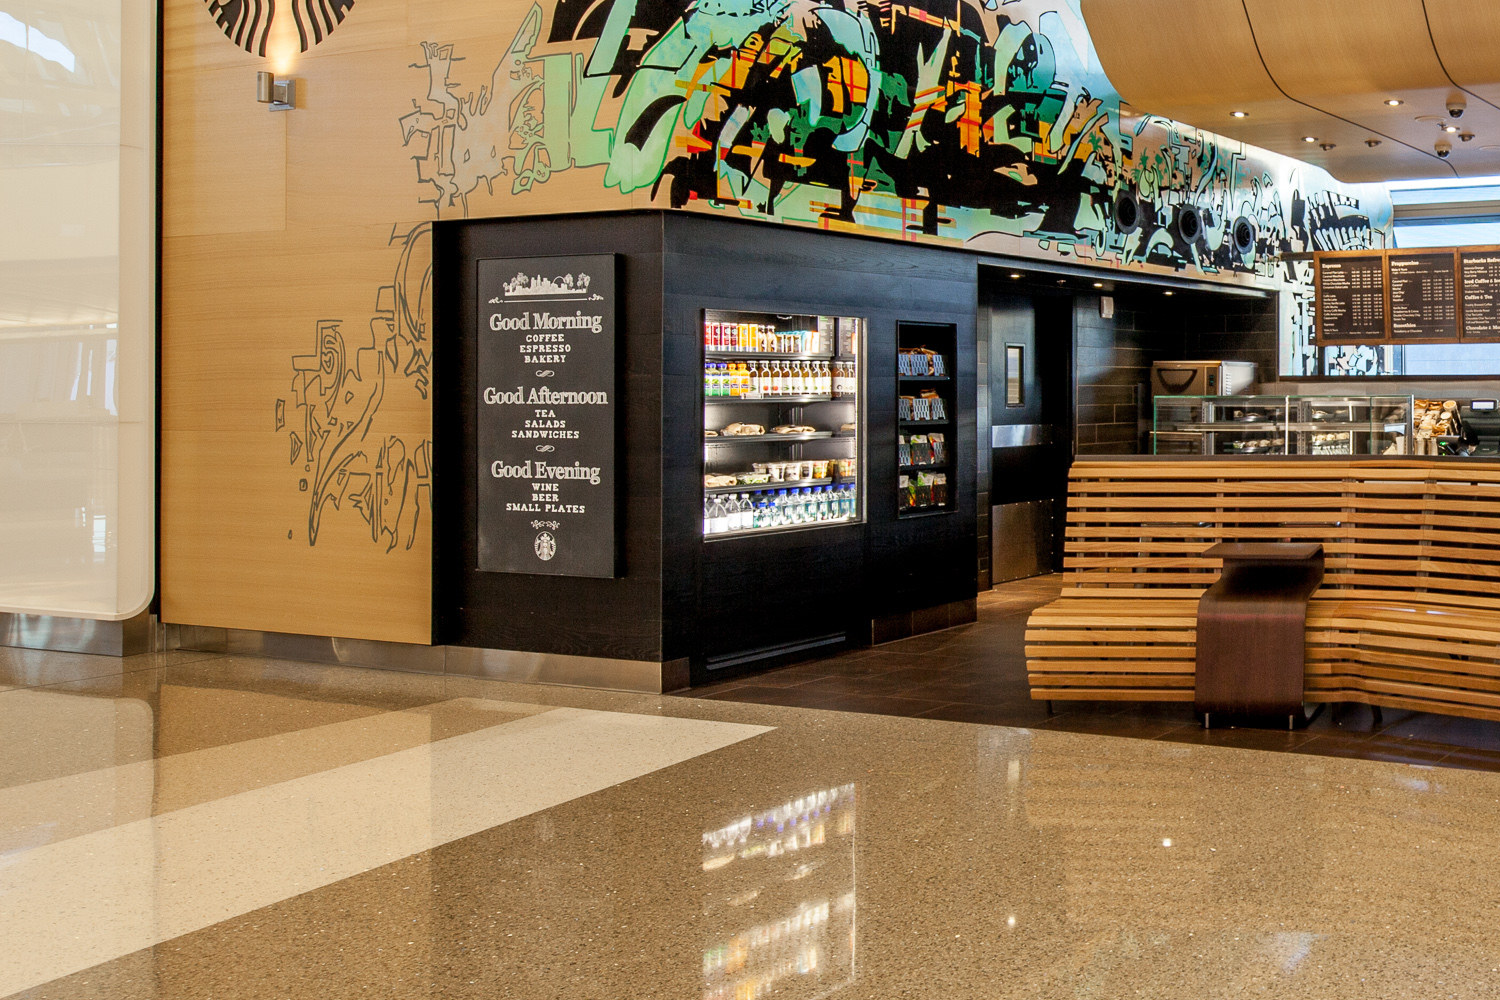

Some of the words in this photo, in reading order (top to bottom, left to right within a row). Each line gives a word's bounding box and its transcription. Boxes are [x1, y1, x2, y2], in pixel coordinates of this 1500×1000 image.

[489, 312, 531, 331] Good
[532, 310, 603, 334] Morning
[525, 334, 565, 342] COFFEE
[519, 344, 571, 353] ESPRESSO
[524, 355, 566, 363] BAKERY
[483, 386, 525, 405] Good
[526, 386, 609, 405] Afternoon
[534, 409, 556, 418] TEA
[524, 420, 566, 428] SALADS
[511, 430, 580, 439] SANDWICHES
[491, 460, 533, 479] Good
[534, 461, 601, 485] Evening
[531, 483, 559, 491] WINE
[531, 493, 559, 502] BEER
[505, 503, 541, 512] SMALL
[545, 504, 586, 513] PLATES
